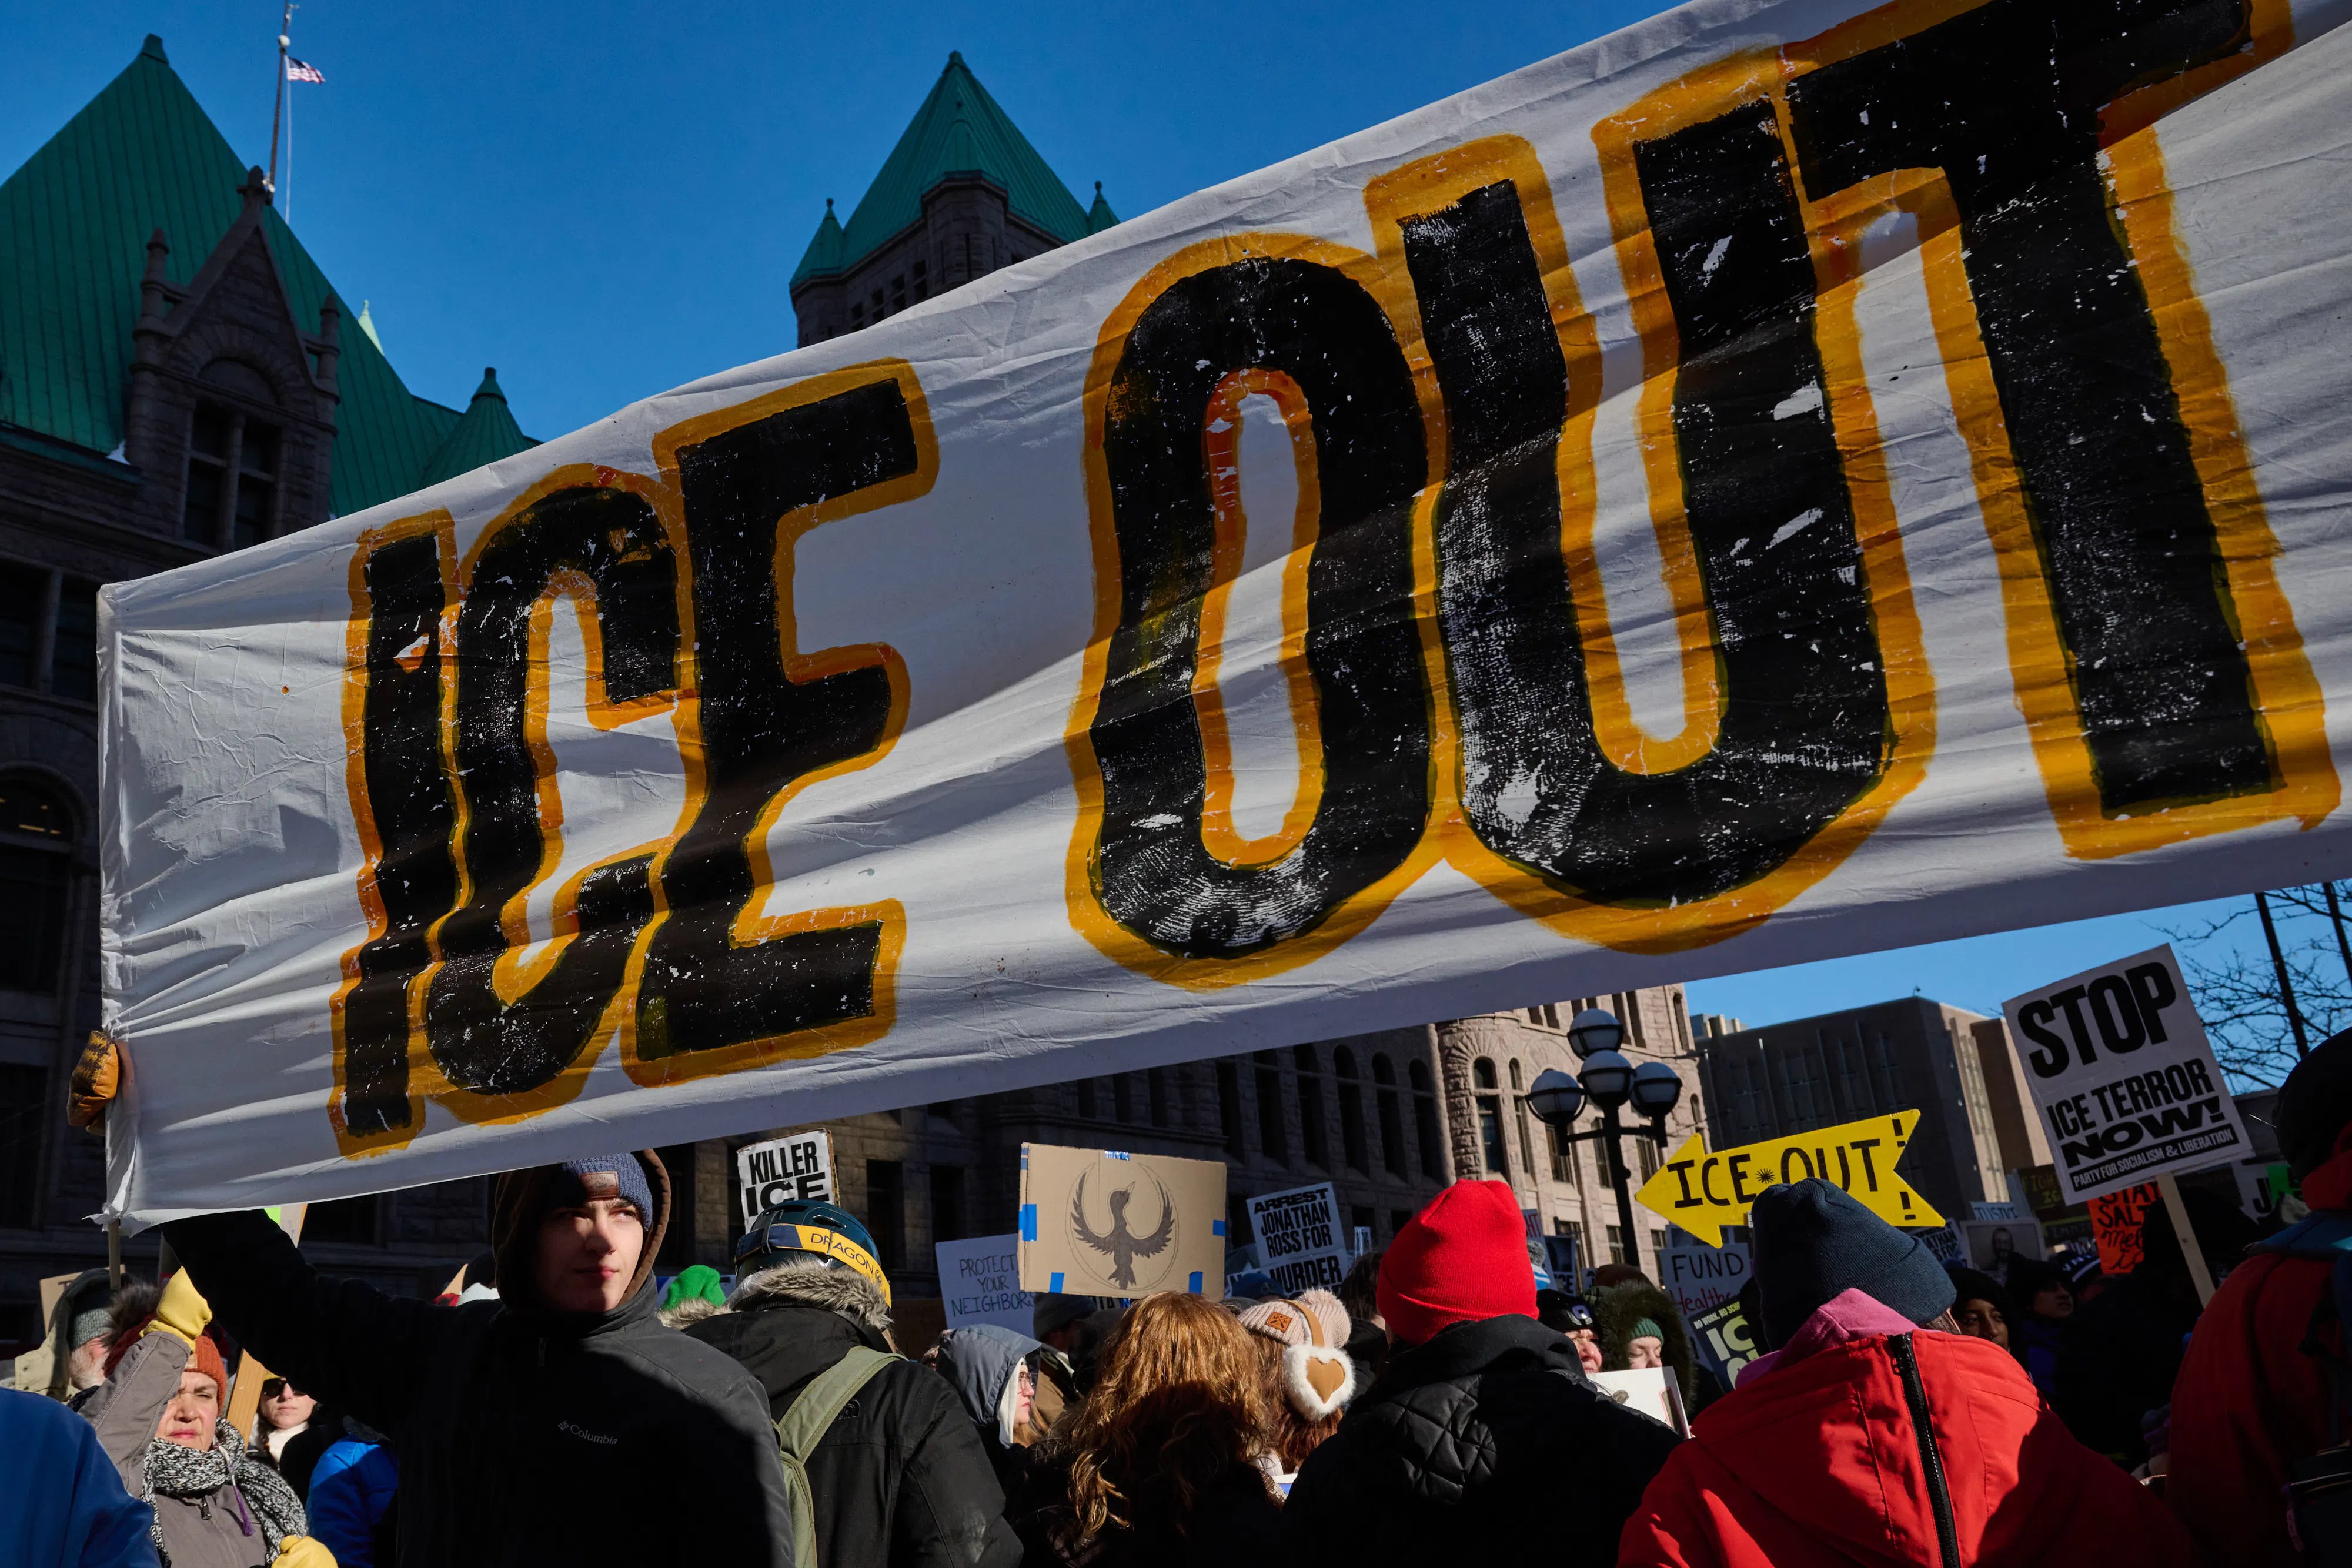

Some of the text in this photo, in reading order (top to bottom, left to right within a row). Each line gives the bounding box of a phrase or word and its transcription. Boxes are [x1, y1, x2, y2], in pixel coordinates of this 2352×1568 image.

[331, 0, 2336, 1157] ICE OUT
[2017, 962, 2176, 1079] STOP
[2046, 1058, 2214, 1141] ICE TERROR
[2061, 1095, 2225, 1168] NOW!
[748, 1141, 818, 1185] KILLER
[2072, 1128, 2234, 1188] PARTY FOR SOCIALISM & LIBERATION
[746, 1172, 829, 1217] ICE
[1254, 1188, 1328, 1214] ARREST
[1666, 1153, 1756, 1209] ICE
[1261, 1201, 1331, 1236] JONATHAN
[1266, 1224, 1332, 1259] ROSS FOR
[960, 1254, 1015, 1278] PROTECT
[978, 1275, 1010, 1293] YOUR
[1269, 1255, 1342, 1293] MURDER
[1671, 1252, 1743, 1282] FUND
[1706, 1315, 1755, 1362] IC
[570, 1425, 618, 1444] Columbia
